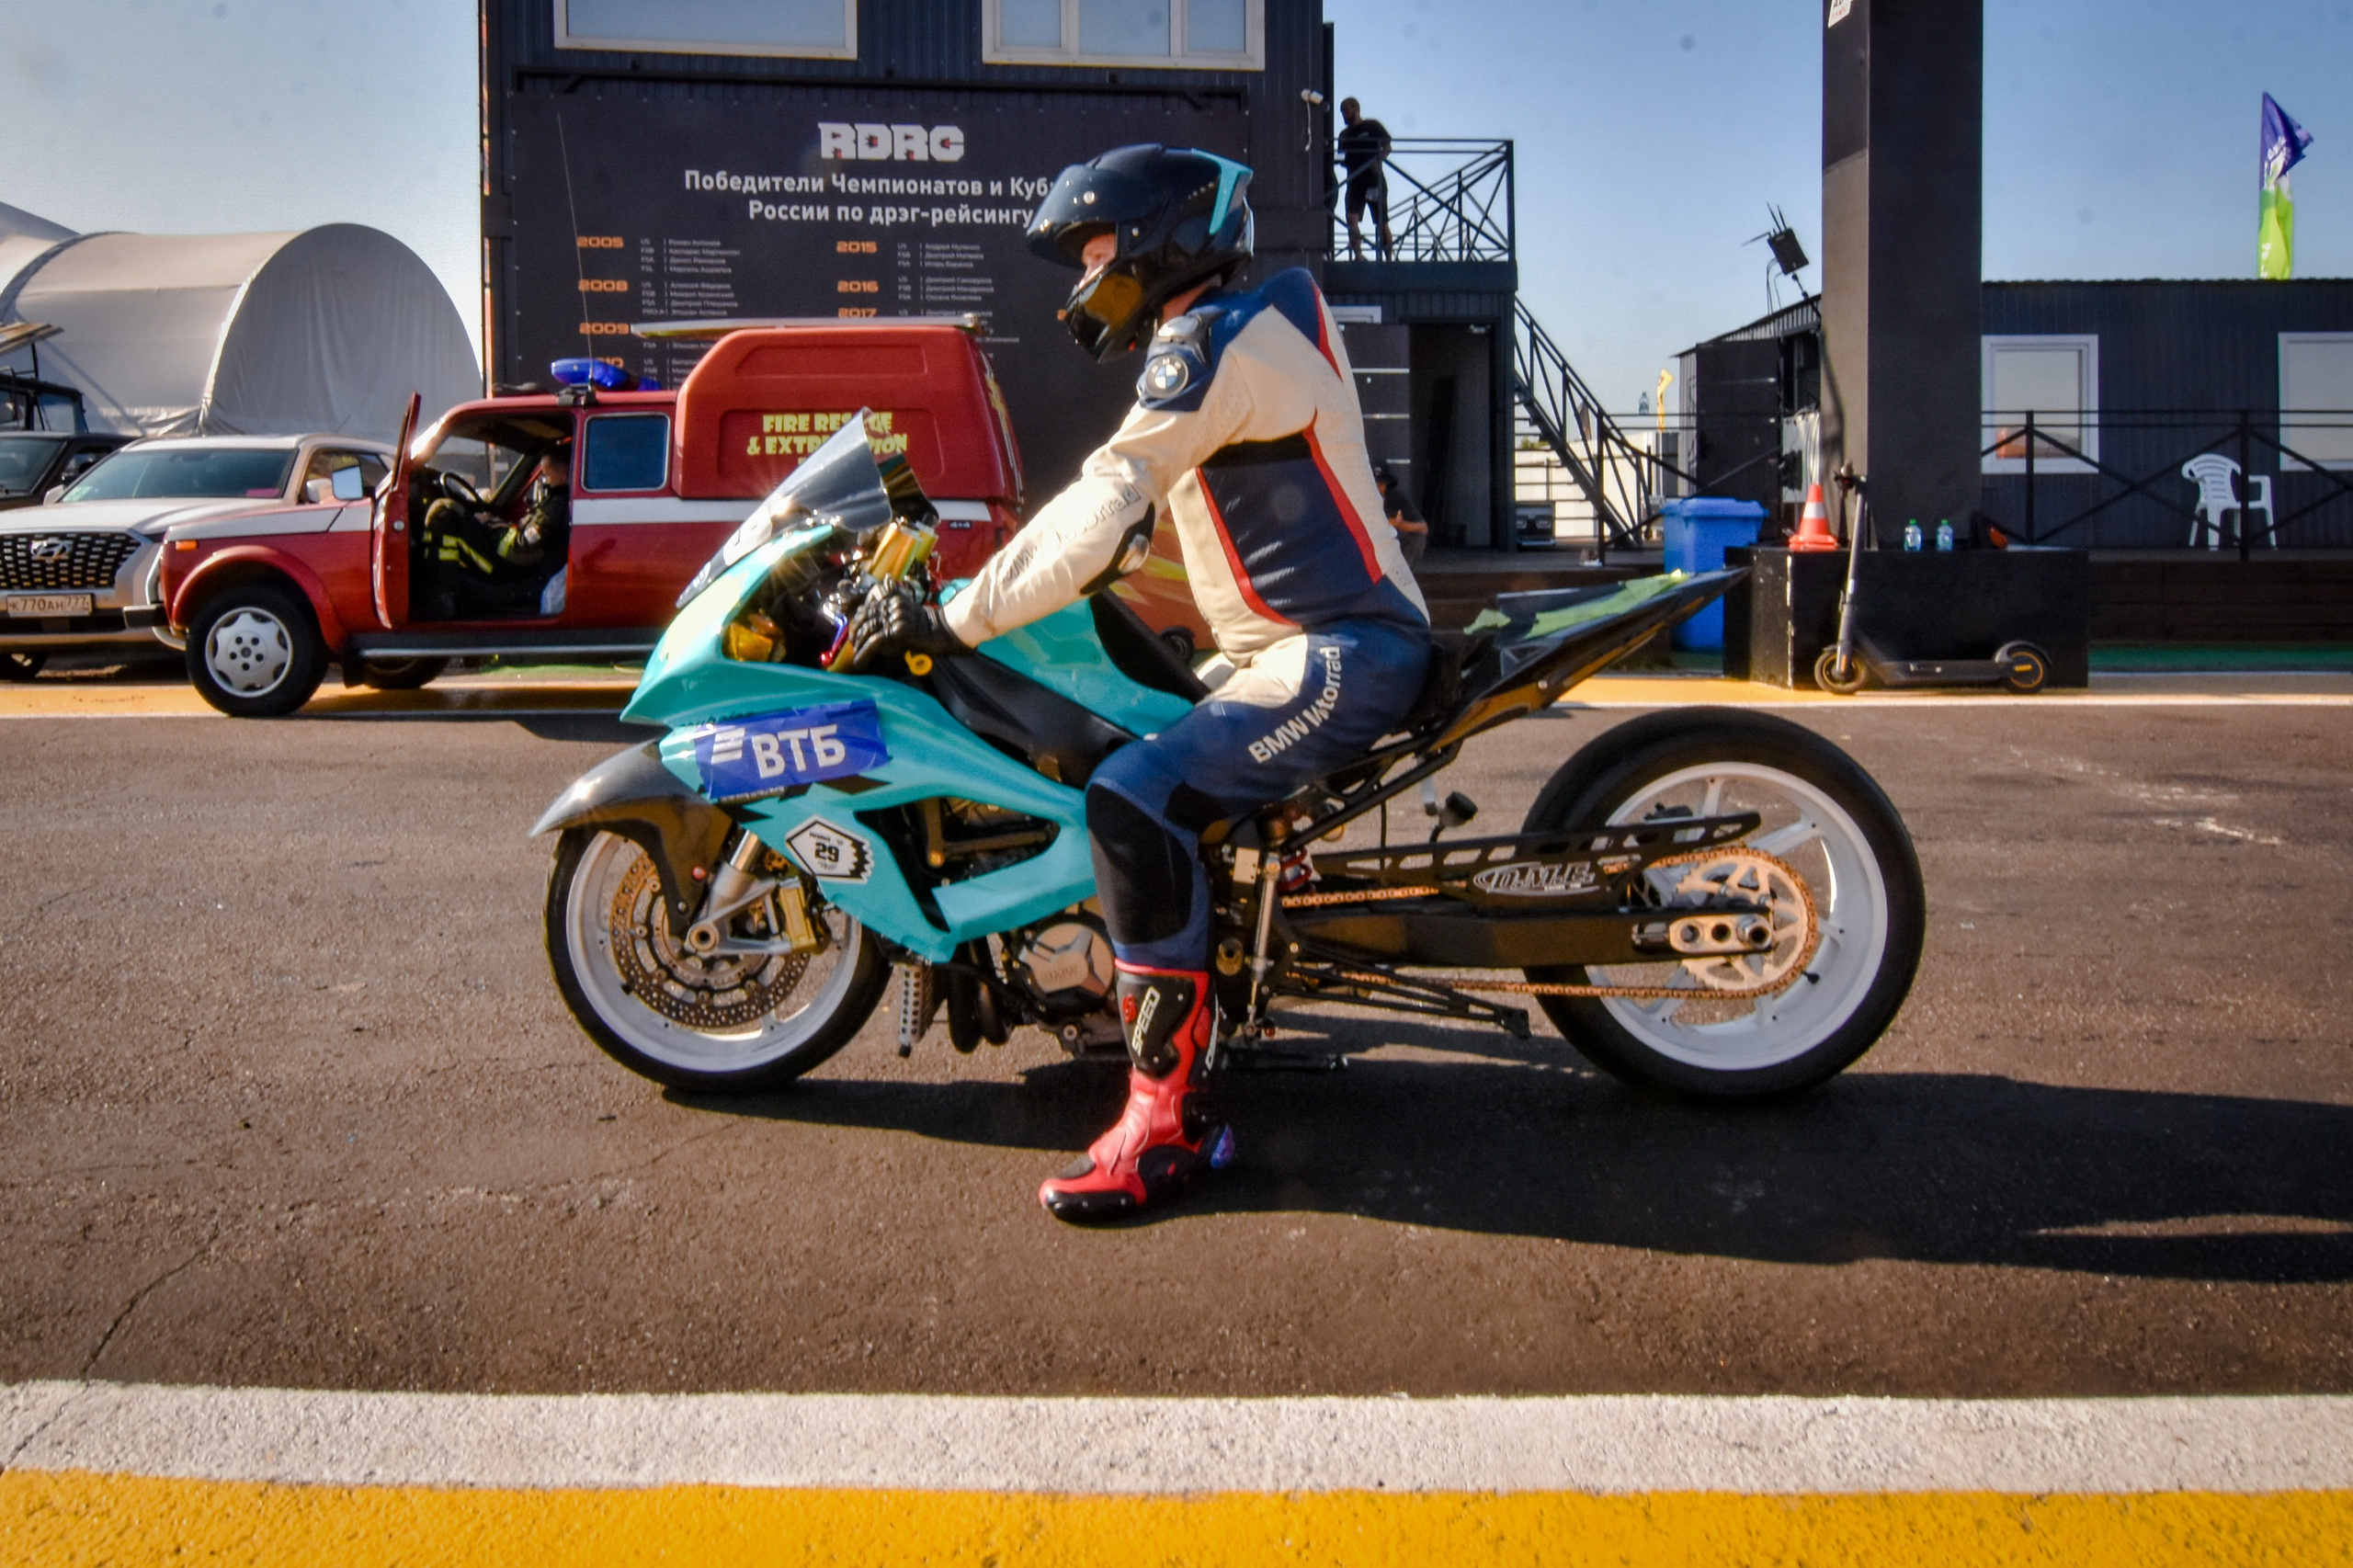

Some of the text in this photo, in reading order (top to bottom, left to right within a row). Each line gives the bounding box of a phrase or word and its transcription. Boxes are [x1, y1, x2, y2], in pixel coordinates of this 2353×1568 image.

[818, 121, 965, 162] RDRC
[685, 169, 824, 194] Победители
[831, 173, 983, 197] Чемпионатов
[989, 180, 1003, 196] и
[749, 199, 1035, 228] России по дрэг-рейсингу
[577, 236, 624, 248] 2005
[836, 241, 878, 254] 2015
[578, 279, 629, 292] 2008
[837, 280, 880, 293] 2016
[579, 323, 630, 335] 2009
[763, 412, 892, 434] FIRE RESUE
[746, 437, 761, 456] &
[1248, 715, 1310, 764] BMW
[751, 723, 846, 779] ВТБ
[813, 842, 840, 862] 29
